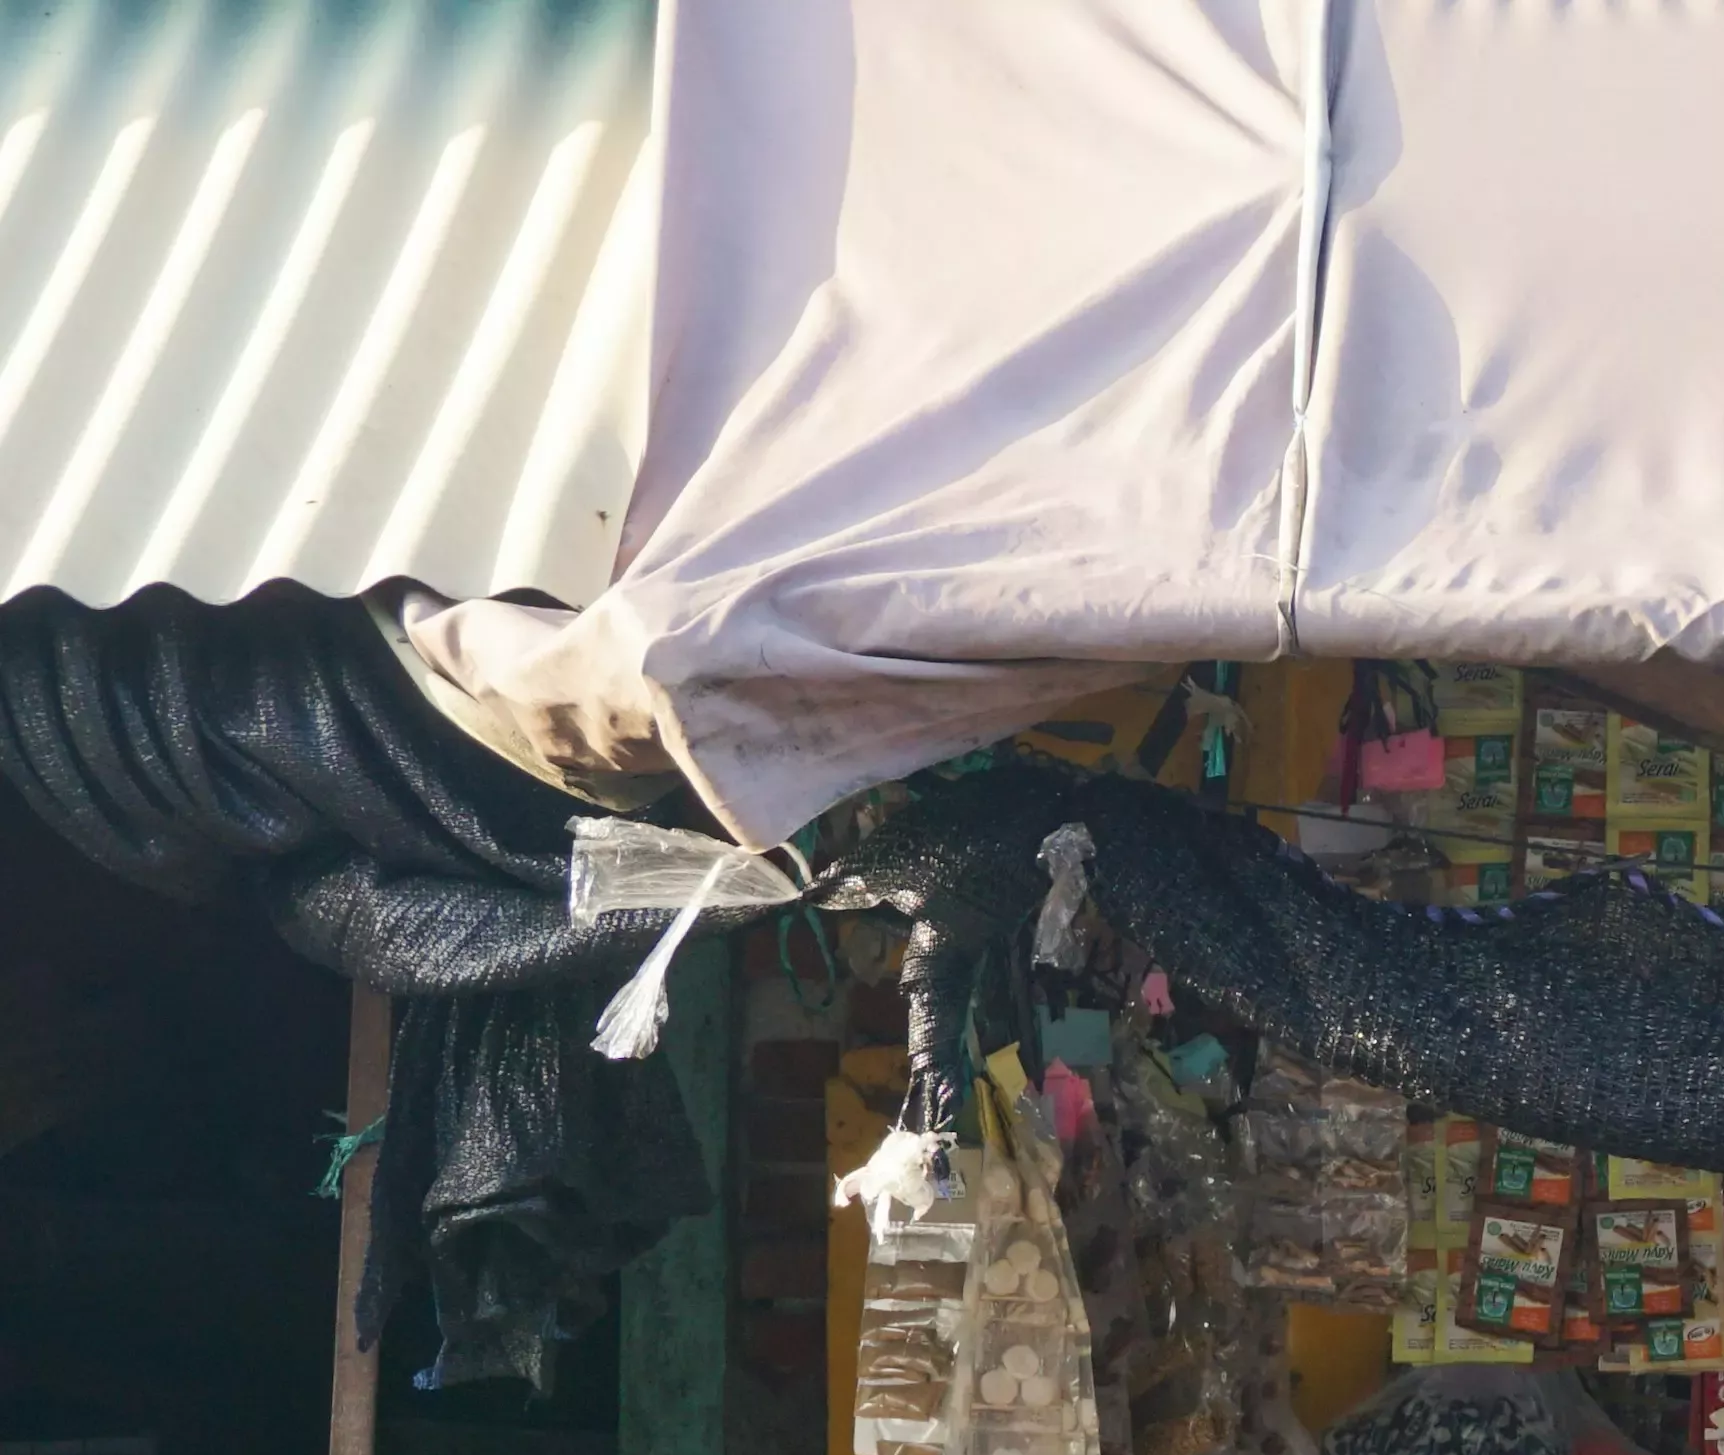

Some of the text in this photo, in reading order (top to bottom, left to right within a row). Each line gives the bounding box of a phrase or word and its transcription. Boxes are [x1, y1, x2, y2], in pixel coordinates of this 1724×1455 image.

[1637, 759, 1680, 778] Serai
[1600, 1245, 1675, 1264] Kayu Manis
[1481, 1254, 1554, 1280] Kayu Manis
